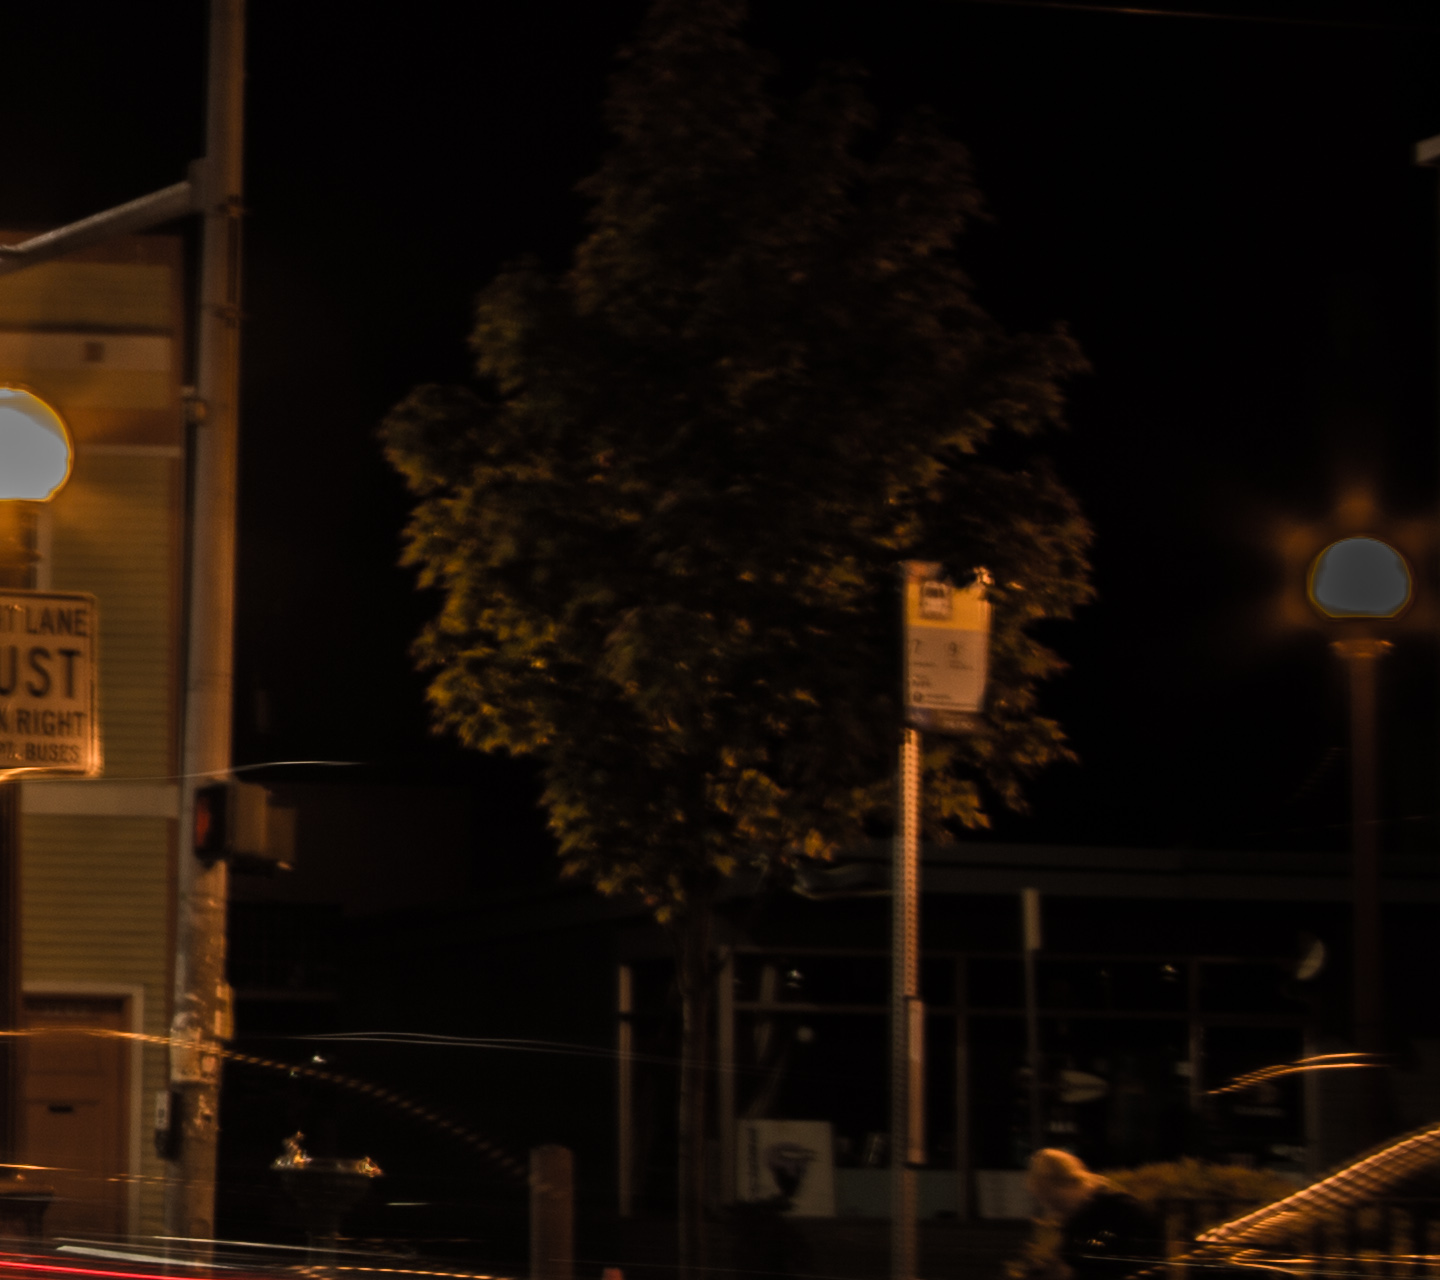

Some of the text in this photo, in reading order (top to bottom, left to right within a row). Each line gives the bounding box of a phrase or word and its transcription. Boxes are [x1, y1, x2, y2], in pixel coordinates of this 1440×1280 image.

[26, 607, 89, 637] LANE
[16, 708, 87, 737] RIGHT
[24, 742, 80, 763] BUSES
